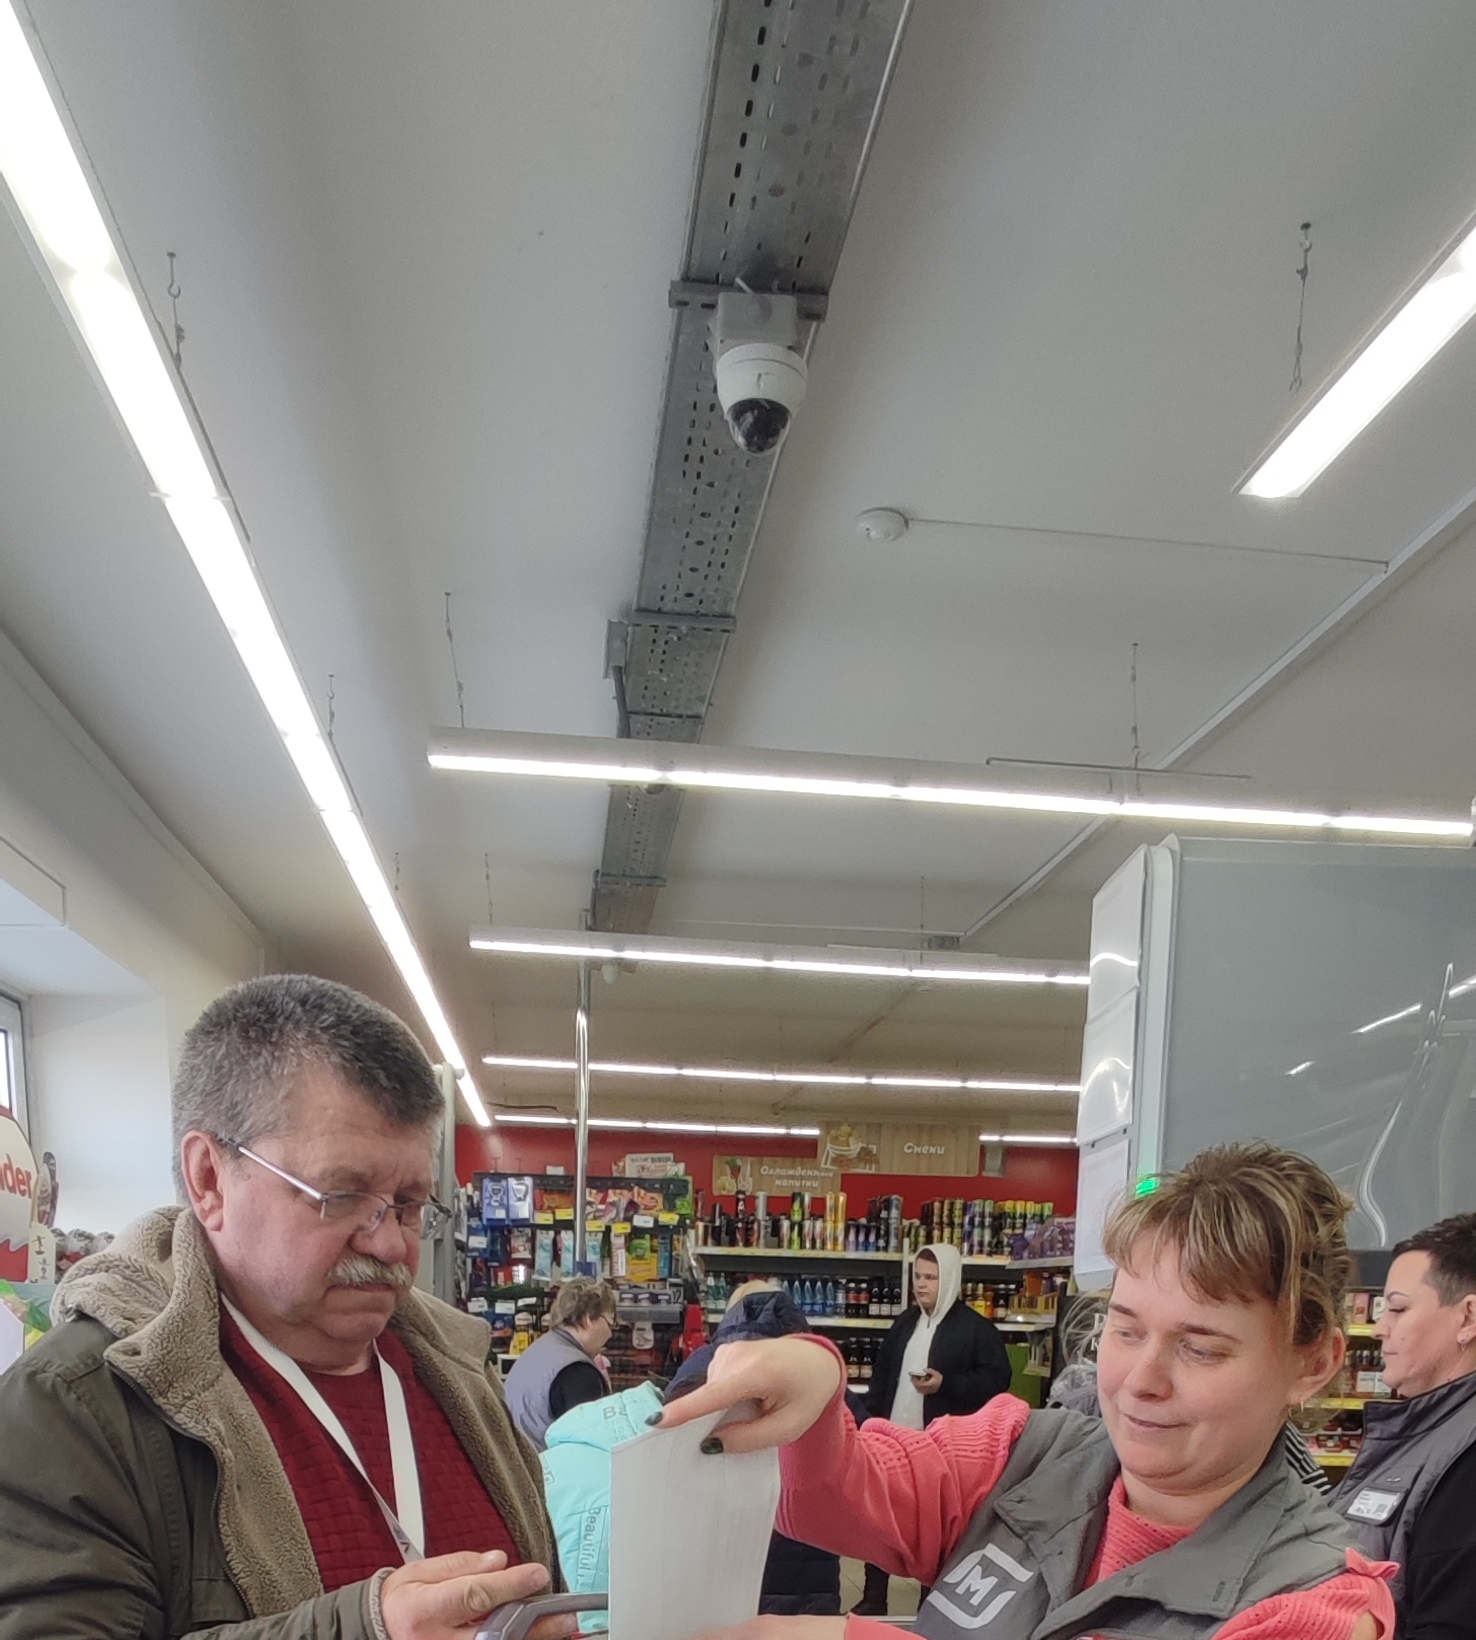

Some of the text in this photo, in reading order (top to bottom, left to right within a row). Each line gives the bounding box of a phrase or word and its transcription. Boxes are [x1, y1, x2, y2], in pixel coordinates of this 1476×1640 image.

[903, 1142, 945, 1155] Снеки
[775, 1179, 819, 1188] напитки
[579, 1507, 601, 1571] Beautiful
